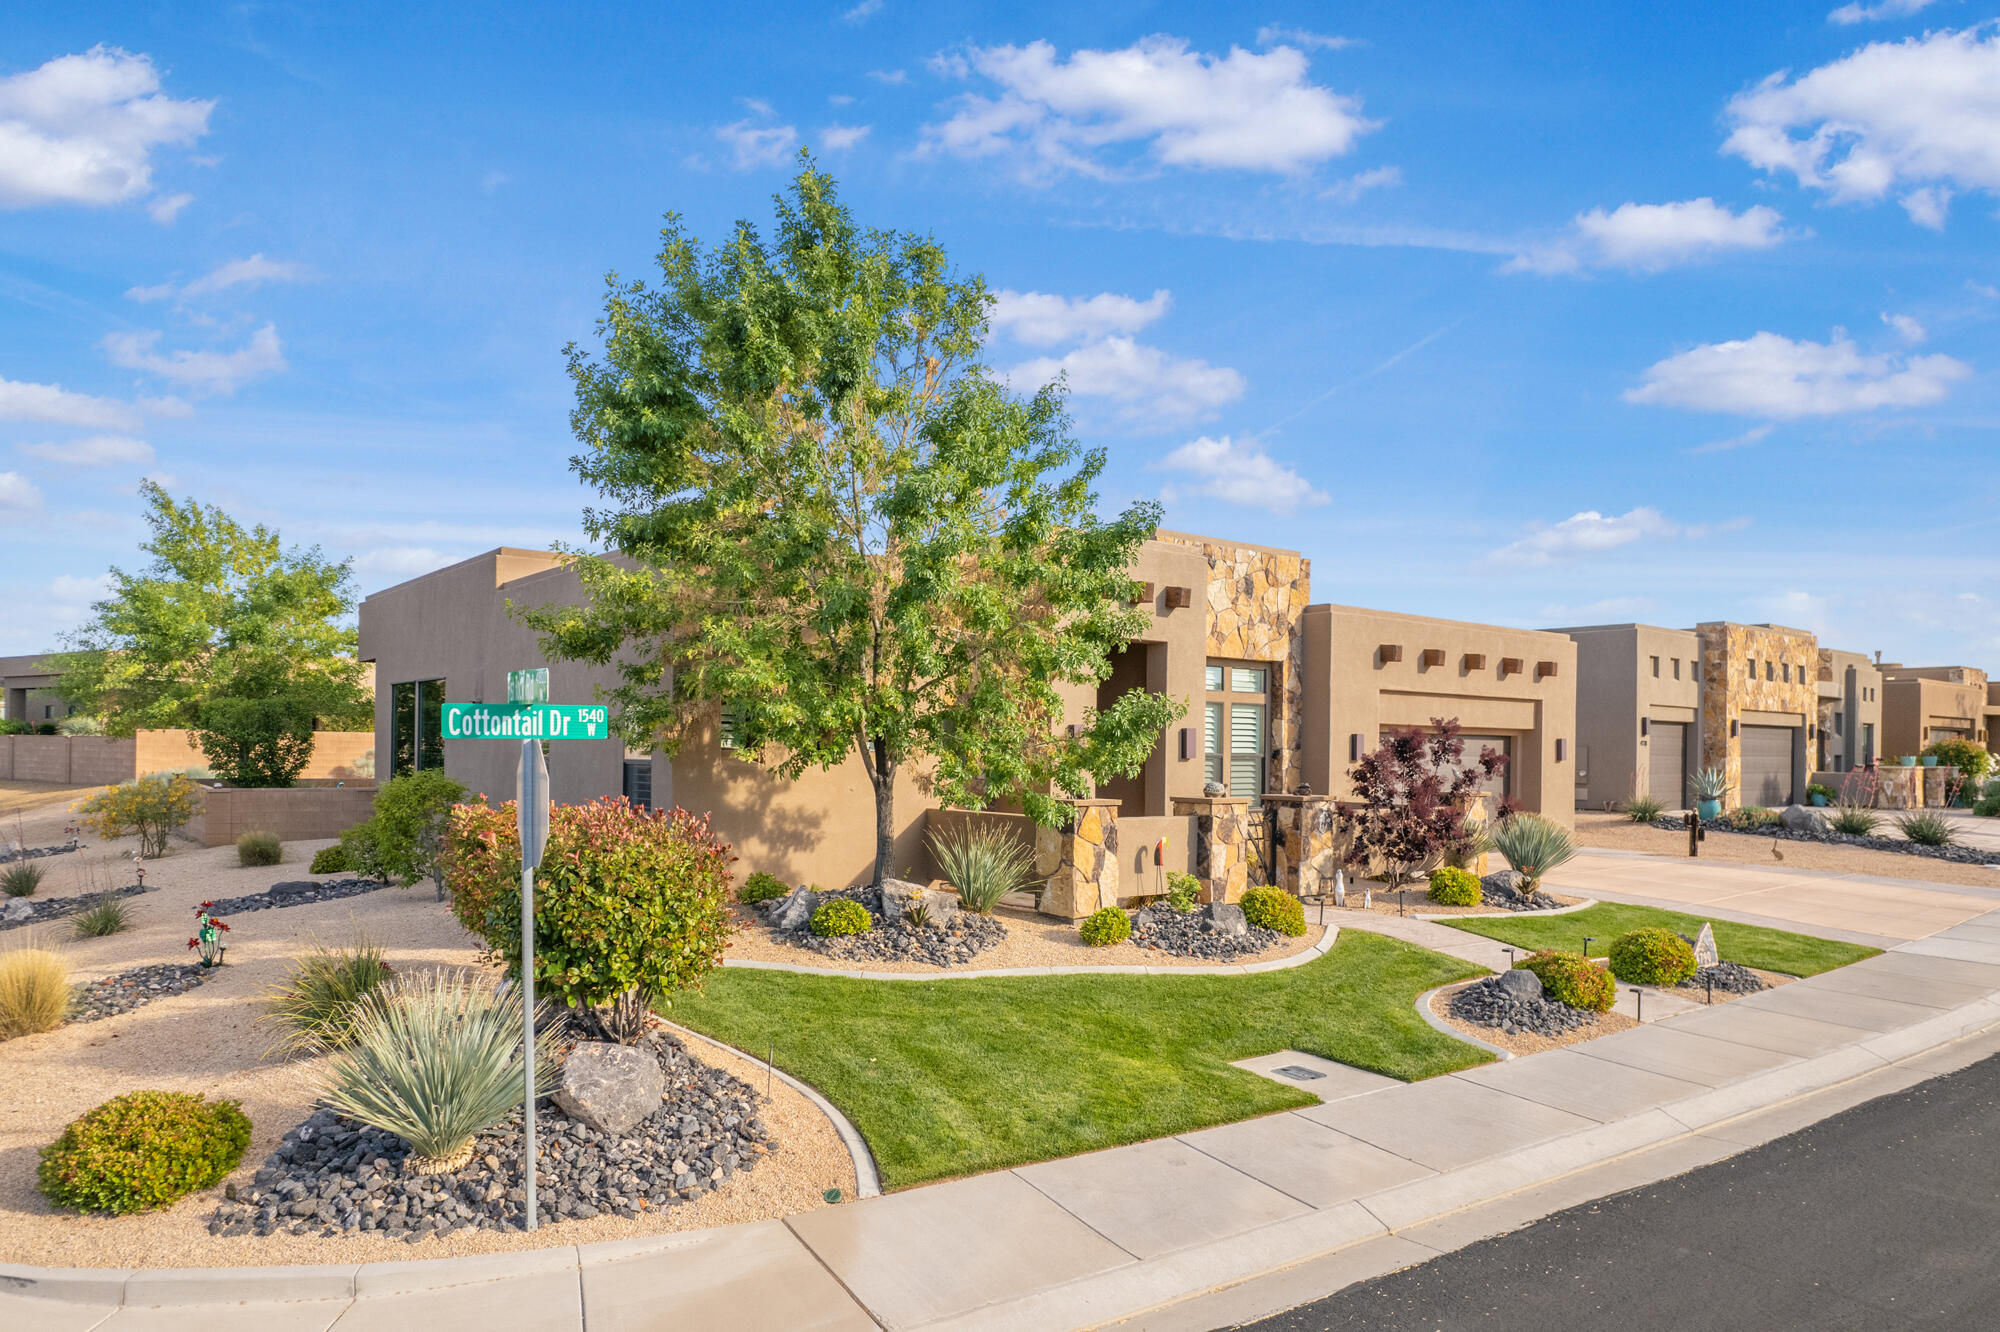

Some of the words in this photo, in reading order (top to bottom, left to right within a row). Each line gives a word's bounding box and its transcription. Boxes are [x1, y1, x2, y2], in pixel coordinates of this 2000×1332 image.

[448, 707, 543, 737] Cottontail
[550, 709, 571, 737] Dr
[578, 708, 604, 723] 1540
[587, 722, 597, 737] W
